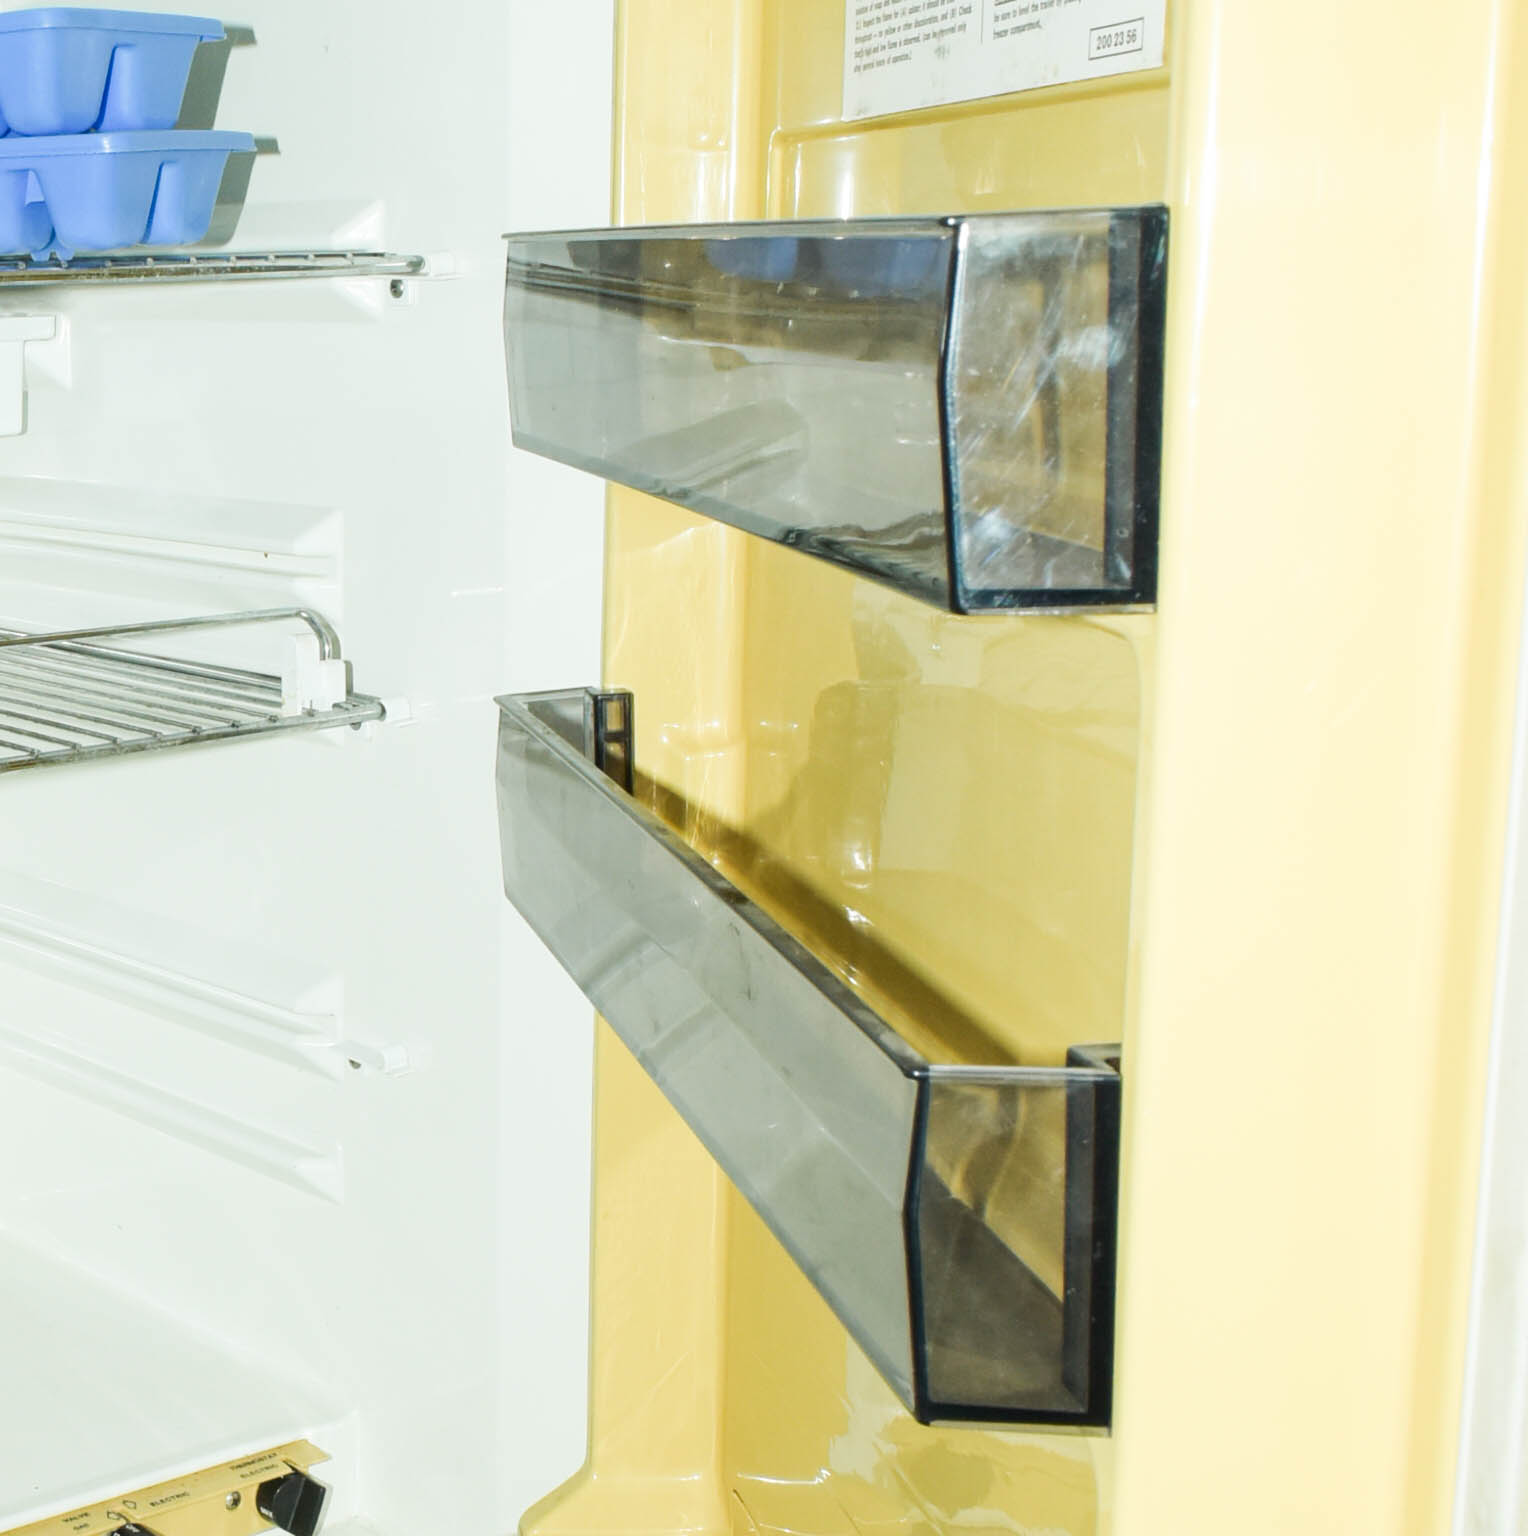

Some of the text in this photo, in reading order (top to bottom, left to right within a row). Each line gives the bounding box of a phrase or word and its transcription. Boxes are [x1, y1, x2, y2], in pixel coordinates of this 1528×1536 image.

[1096, 29, 1137, 50] 200 23 56
